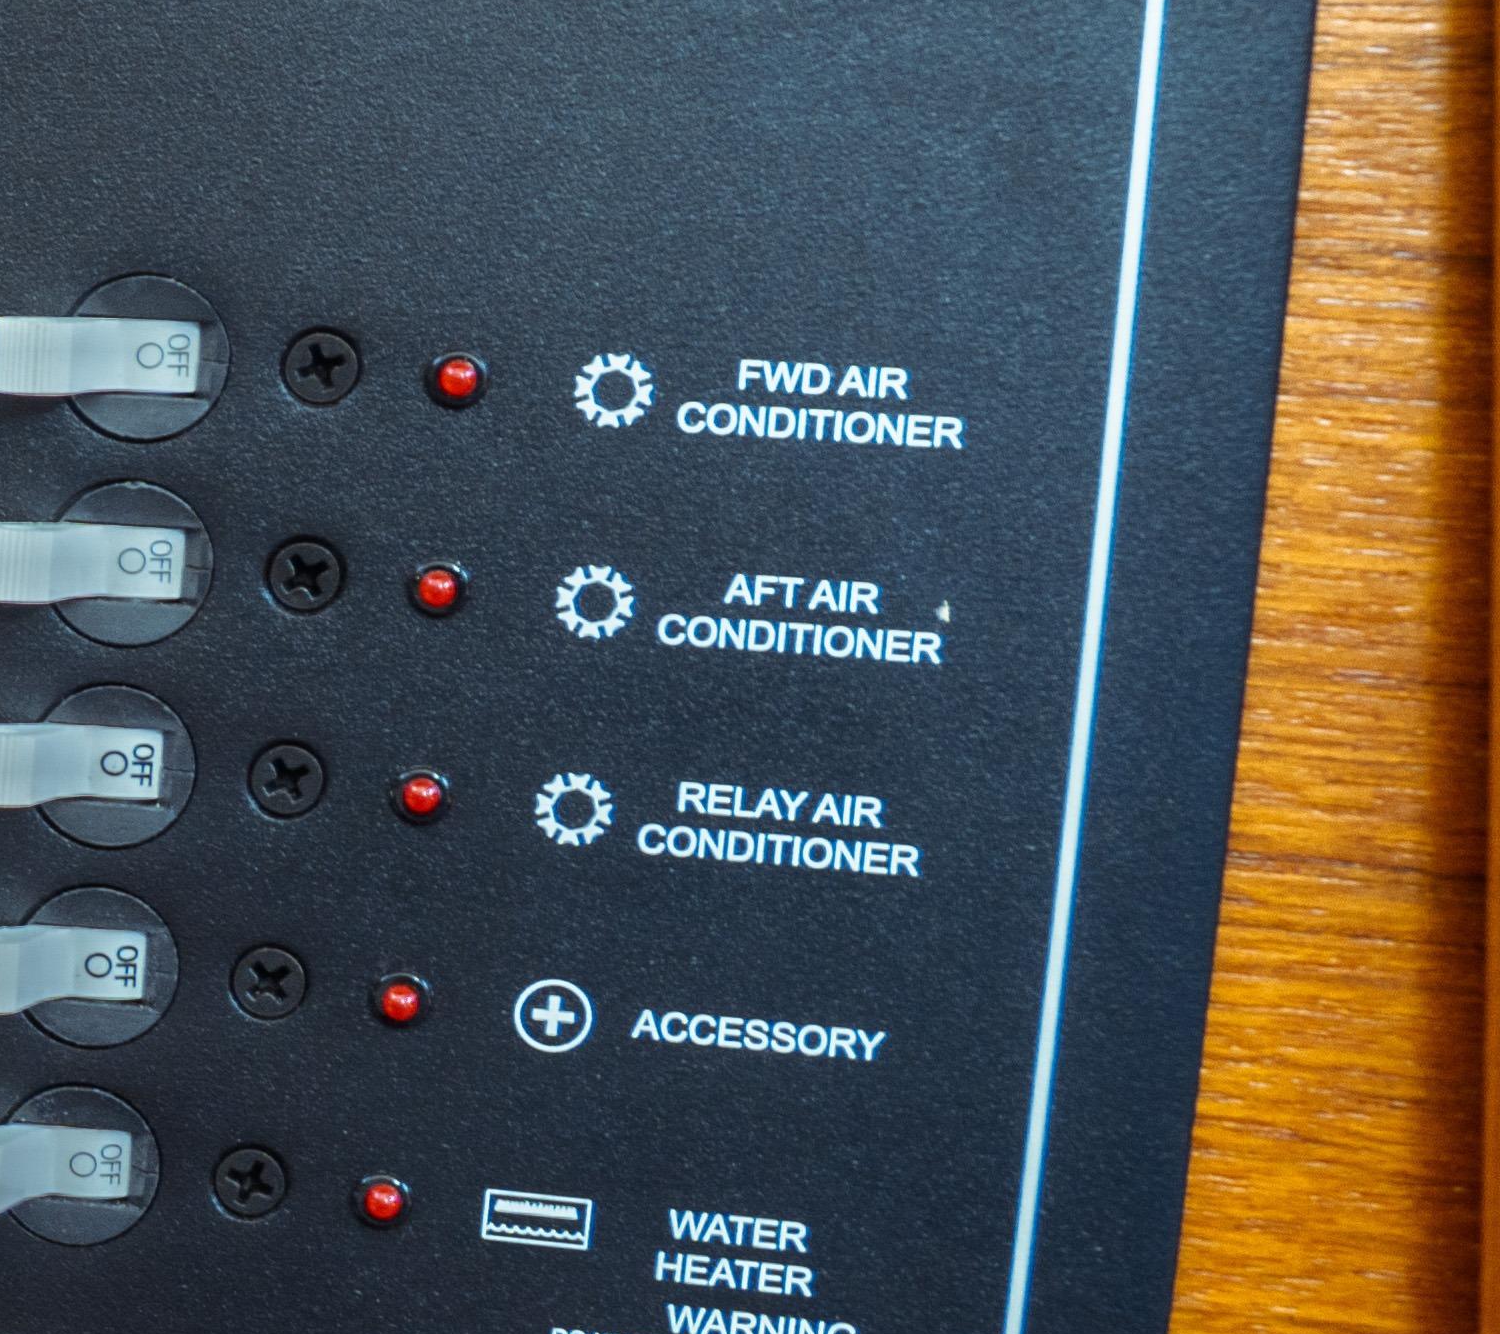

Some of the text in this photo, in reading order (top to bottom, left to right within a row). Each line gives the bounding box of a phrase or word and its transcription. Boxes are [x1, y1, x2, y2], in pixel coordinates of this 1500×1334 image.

[166, 333, 191, 380] OFF
[738, 358, 908, 400] FWD AIR
[676, 401, 963, 450] CONDITIONER
[149, 539, 174, 586] OFF
[723, 573, 879, 615] AFT AIR
[657, 613, 942, 665] CONDITIONER
[132, 742, 156, 790] OFF
[677, 781, 882, 829] RELAY AIR
[637, 823, 919, 878] CONDITIONER
[115, 945, 139, 992] OFF
[630, 1009, 886, 1062] ACCESSORY
[99, 1143, 123, 1190] OFF
[669, 1208, 807, 1253] WATER
[655, 1250, 813, 1298] HEATER
